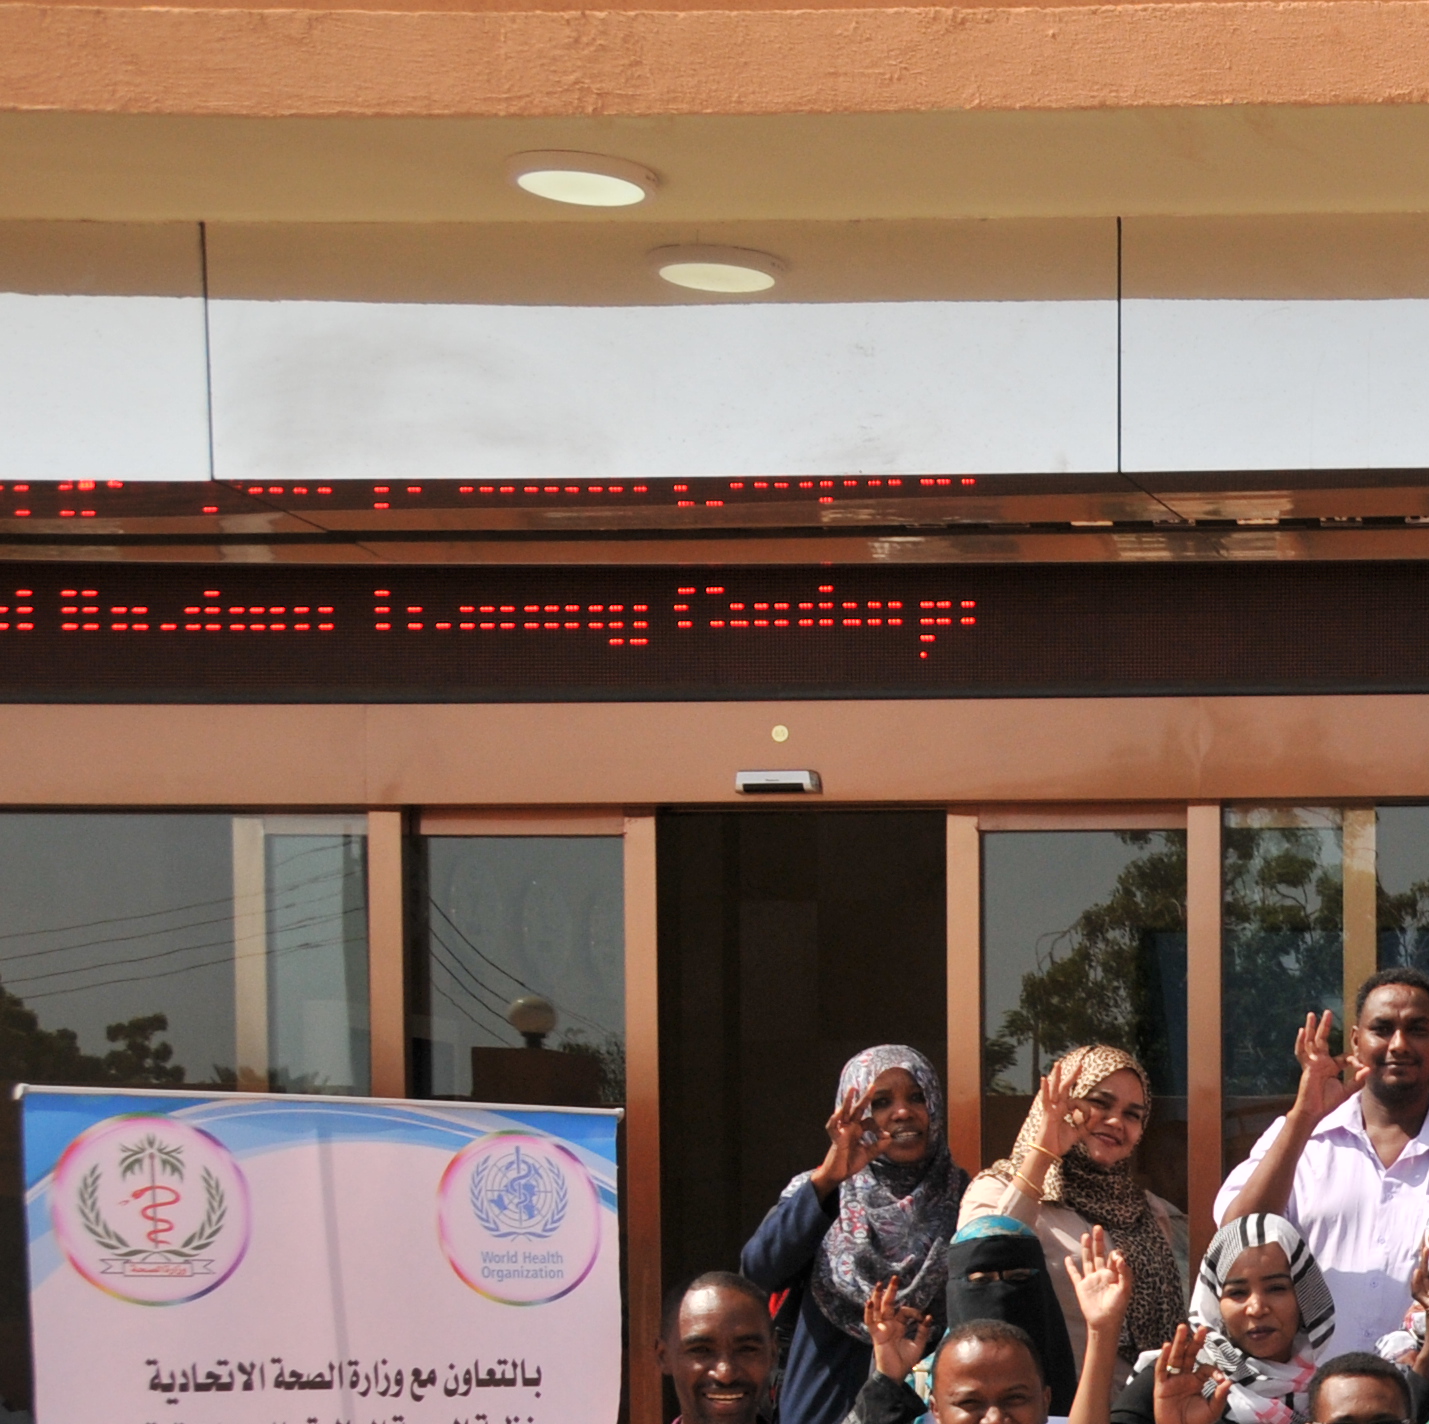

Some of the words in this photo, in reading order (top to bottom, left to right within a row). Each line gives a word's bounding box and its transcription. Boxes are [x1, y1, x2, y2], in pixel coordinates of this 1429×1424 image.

[481, 1250, 518, 1264] World
[523, 1251, 564, 1264] Health
[481, 1265, 565, 1282] Organization
[144, 1358, 265, 1405] الاتحادية
[271, 1357, 344, 1391] الصحة
[347, 1358, 404, 1398] وزارة
[408, 1366, 437, 1401] مع
[442, 1357, 542, 1399] بالتعاون
